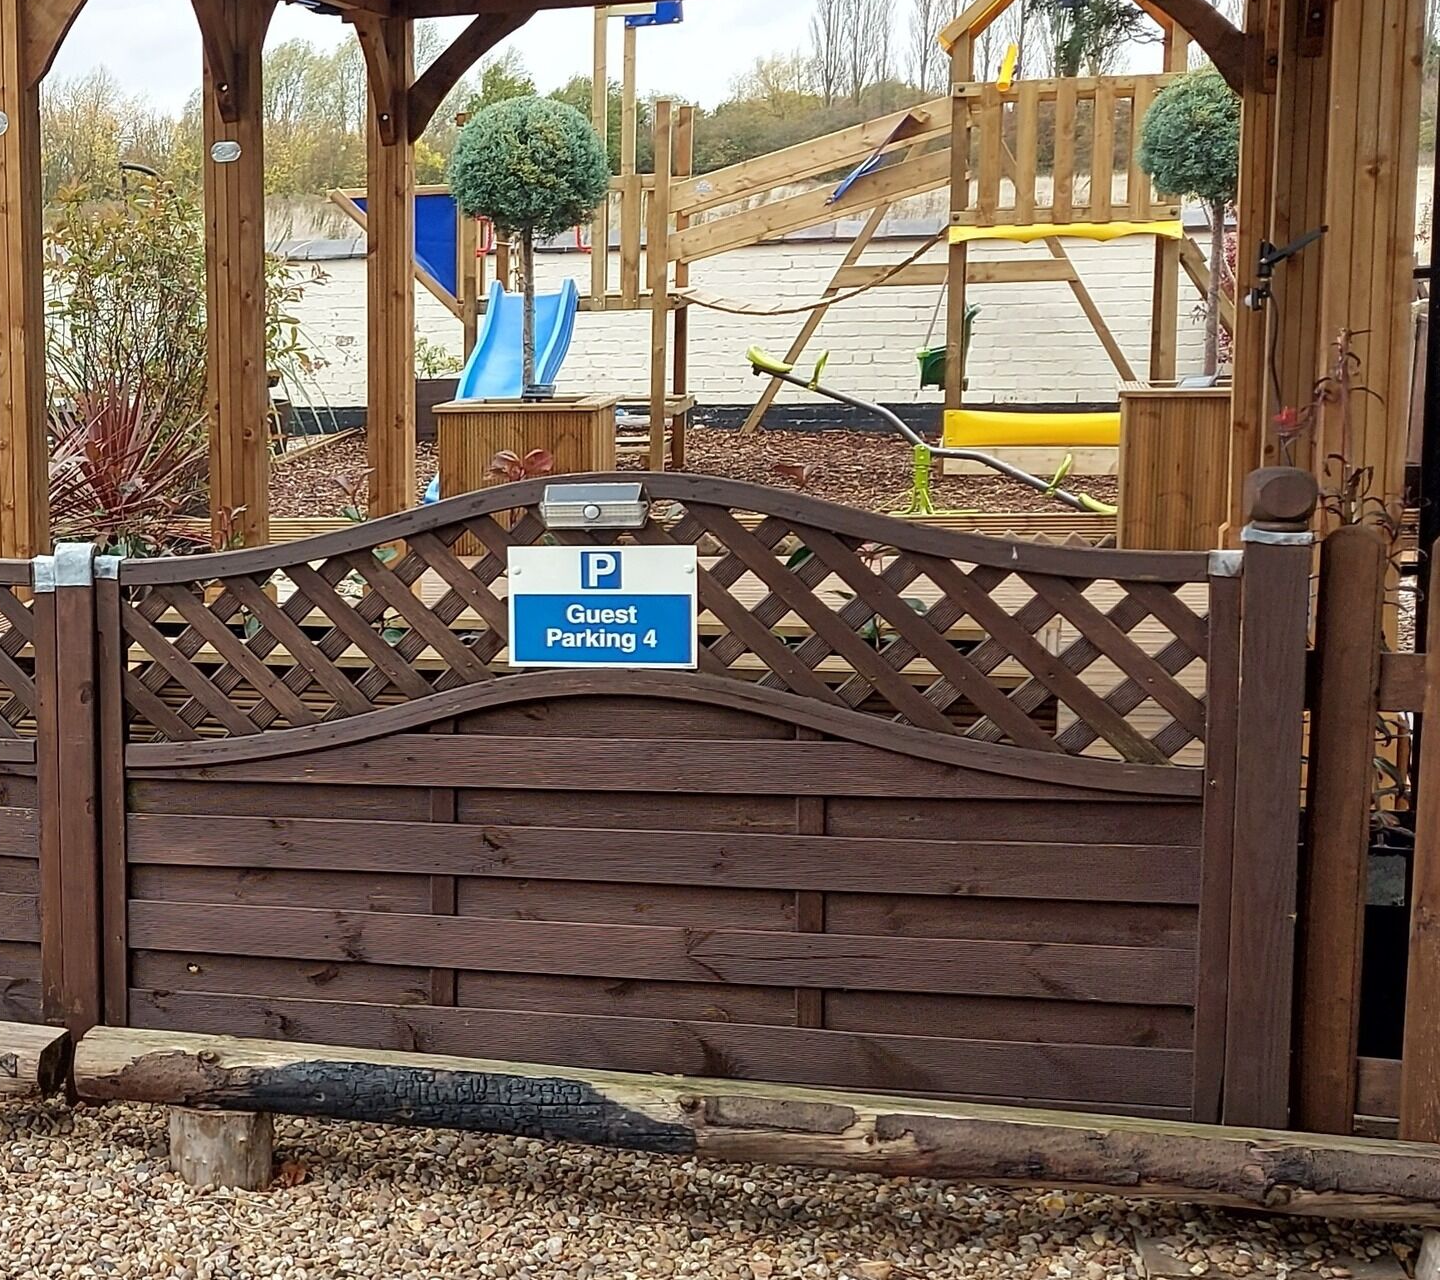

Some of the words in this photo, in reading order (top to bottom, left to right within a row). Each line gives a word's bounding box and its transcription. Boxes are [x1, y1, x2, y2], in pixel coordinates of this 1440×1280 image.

[589, 553, 616, 587] P
[566, 604, 637, 624] Guest
[546, 629, 636, 652] Parking
[643, 629, 657, 648] 4
